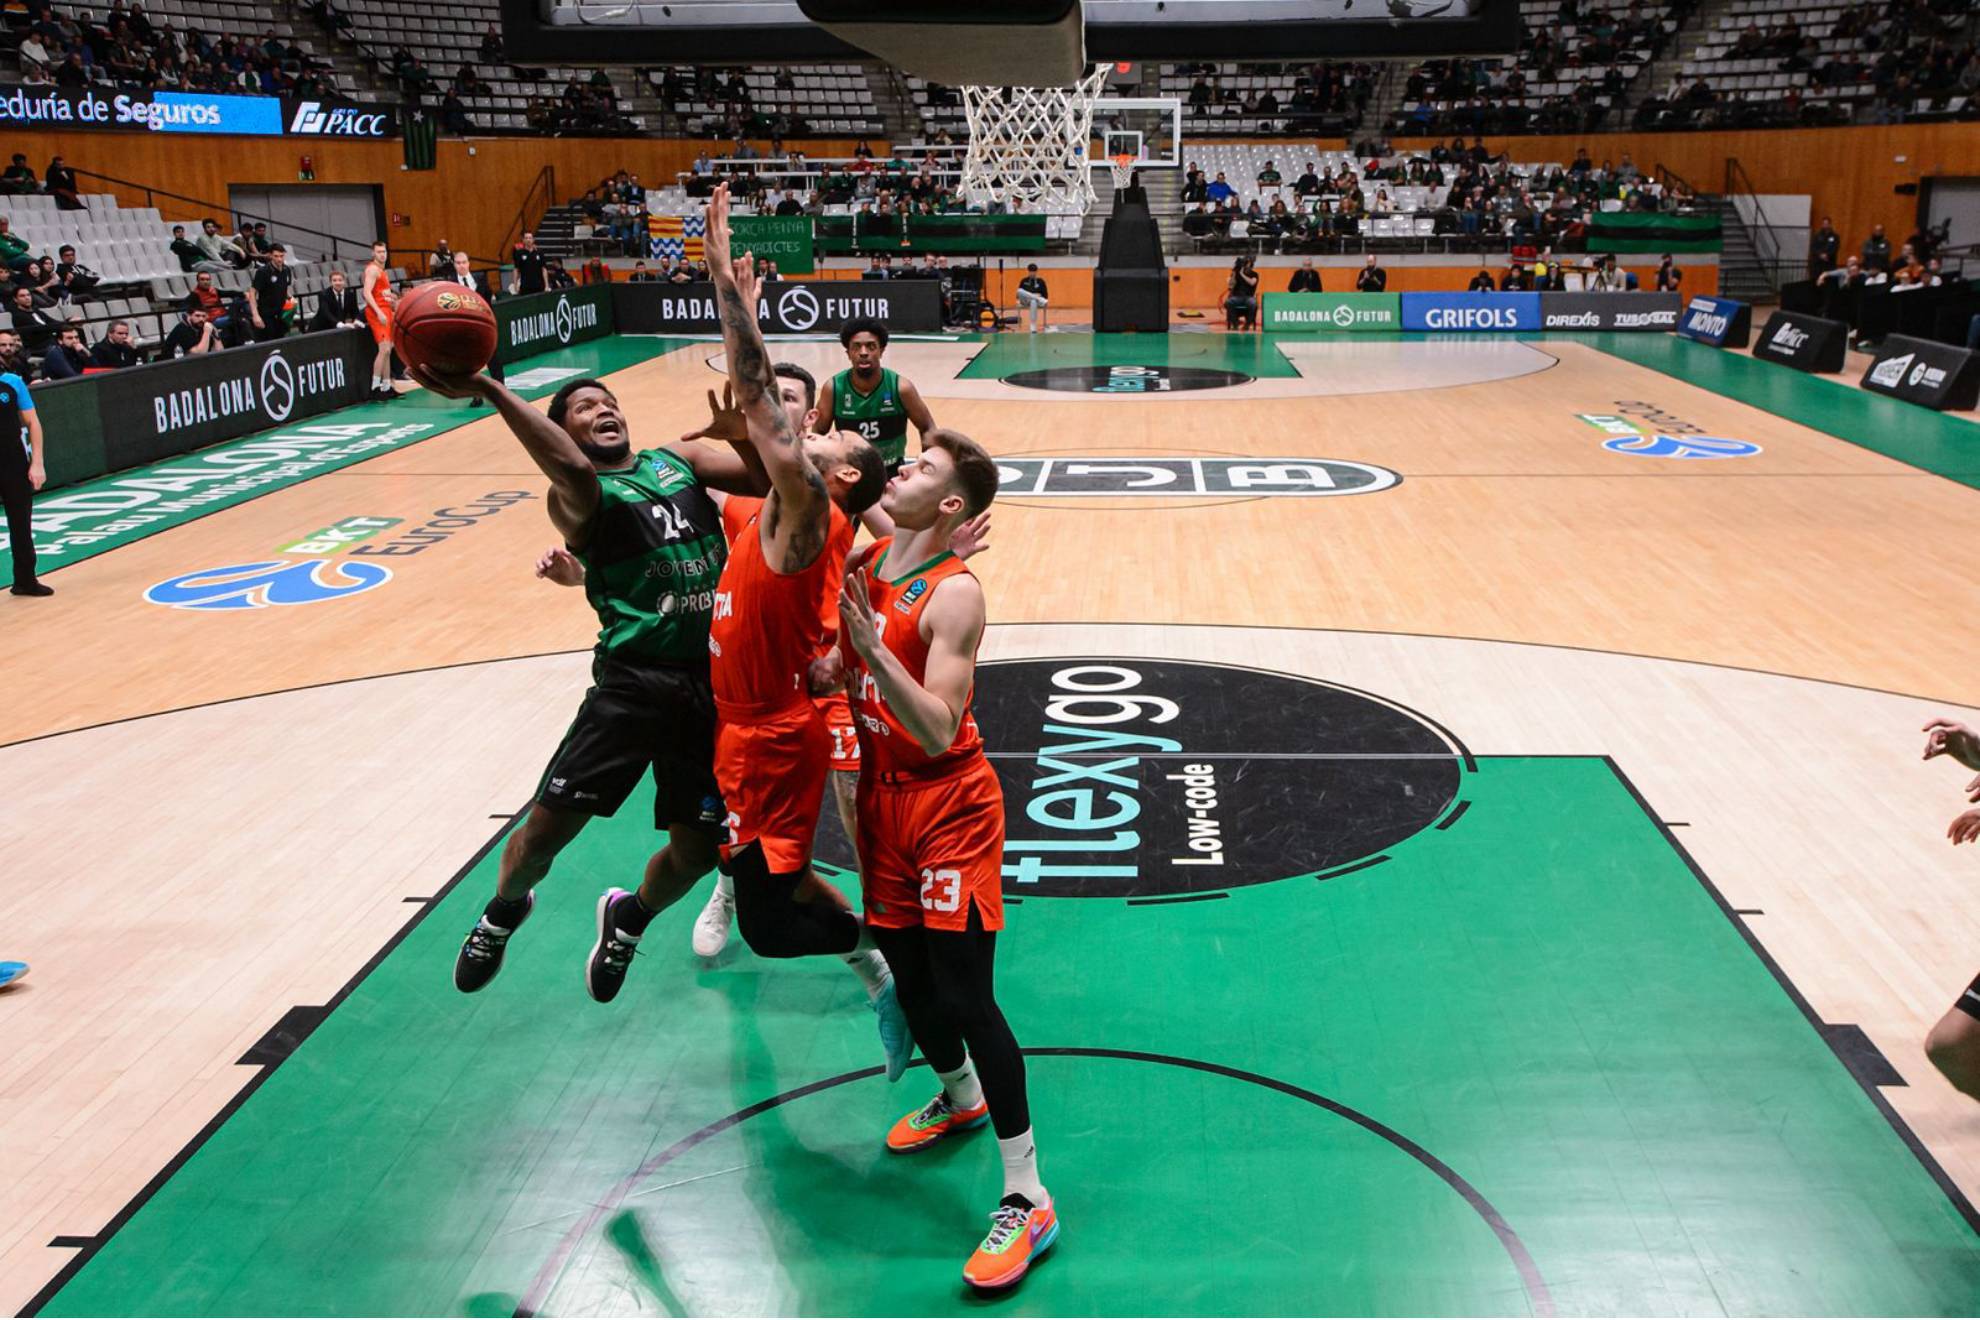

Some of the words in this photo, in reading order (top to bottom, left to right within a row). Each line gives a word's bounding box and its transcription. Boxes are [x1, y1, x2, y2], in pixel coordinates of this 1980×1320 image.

[78, 92, 109, 122] de
[113, 94, 221, 131] Seguros
[323, 113, 387, 136] PACC
[510, 311, 556, 347] BADALONA
[572, 303, 597, 330] FUTUR
[662, 298, 770, 320] BADAA
[826, 298, 889, 320] FUTUR
[1273, 310, 1331, 323] BADALONA
[1356, 310, 1392, 323] FUTUR
[1425, 308, 1518, 329] GRIFOLS
[154, 376, 256, 434] BADALONA
[297, 357, 346, 398] FUTUR
[859, 421, 880, 439] 25
[283, 516, 390, 554] BKT
[349, 490, 539, 556] EuroCup
[651, 502, 694, 540] 24
[1001, 665, 1183, 883] flexygo
[1165, 763, 1225, 865] Low-code
[920, 867, 961, 912] 23
